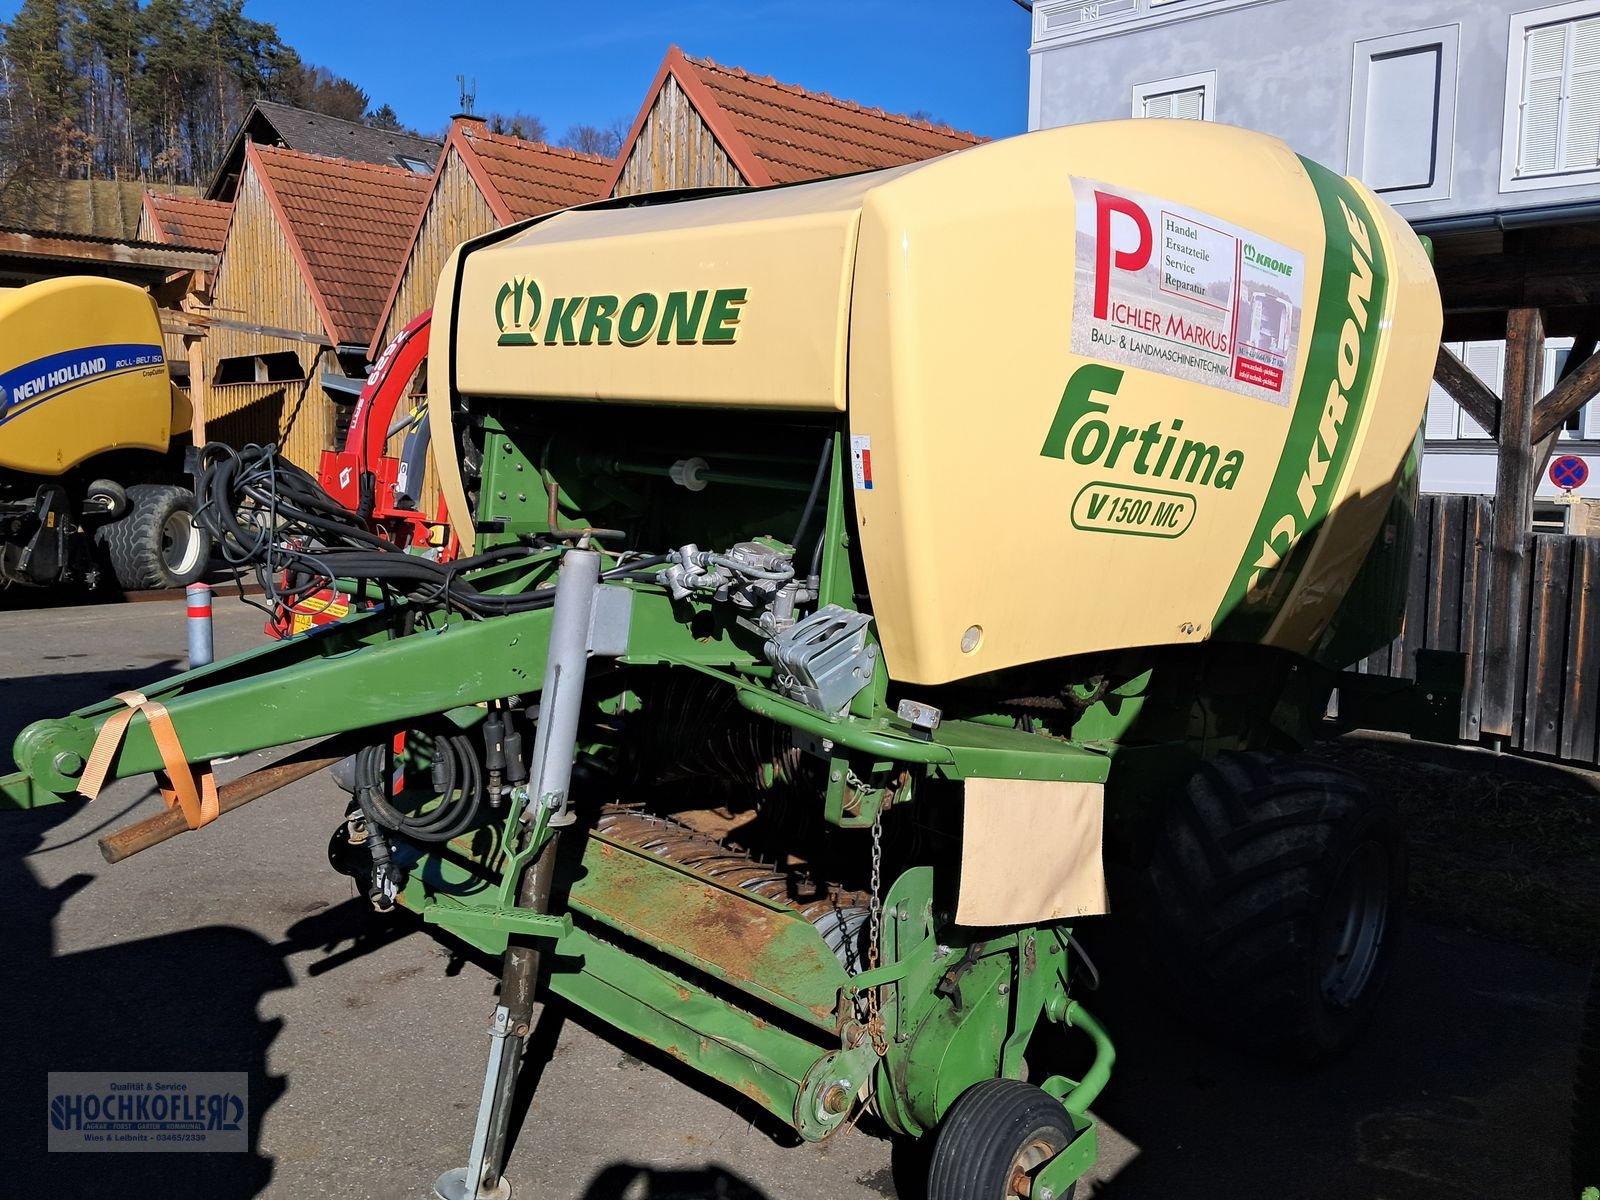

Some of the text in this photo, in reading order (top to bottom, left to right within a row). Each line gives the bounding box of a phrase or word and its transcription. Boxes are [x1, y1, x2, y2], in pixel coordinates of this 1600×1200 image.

[1166, 219, 1198, 241] Handel
[1165, 237, 1210, 262] Ersatzteile
[1165, 255, 1196, 275] Service
[1255, 254, 1293, 277] KRONE
[1164, 272, 1206, 296] Reparatur
[543, 287, 749, 347] KRONE
[1119, 335, 1127, 349] &
[115, 356, 151, 368] ROLL-BELT
[1297, 195, 1374, 519] KRONE
[13, 357, 106, 403] NEW HOLLAND
[1040, 363, 1245, 490] Fortima
[1086, 493, 1185, 528] V 1500 MC
